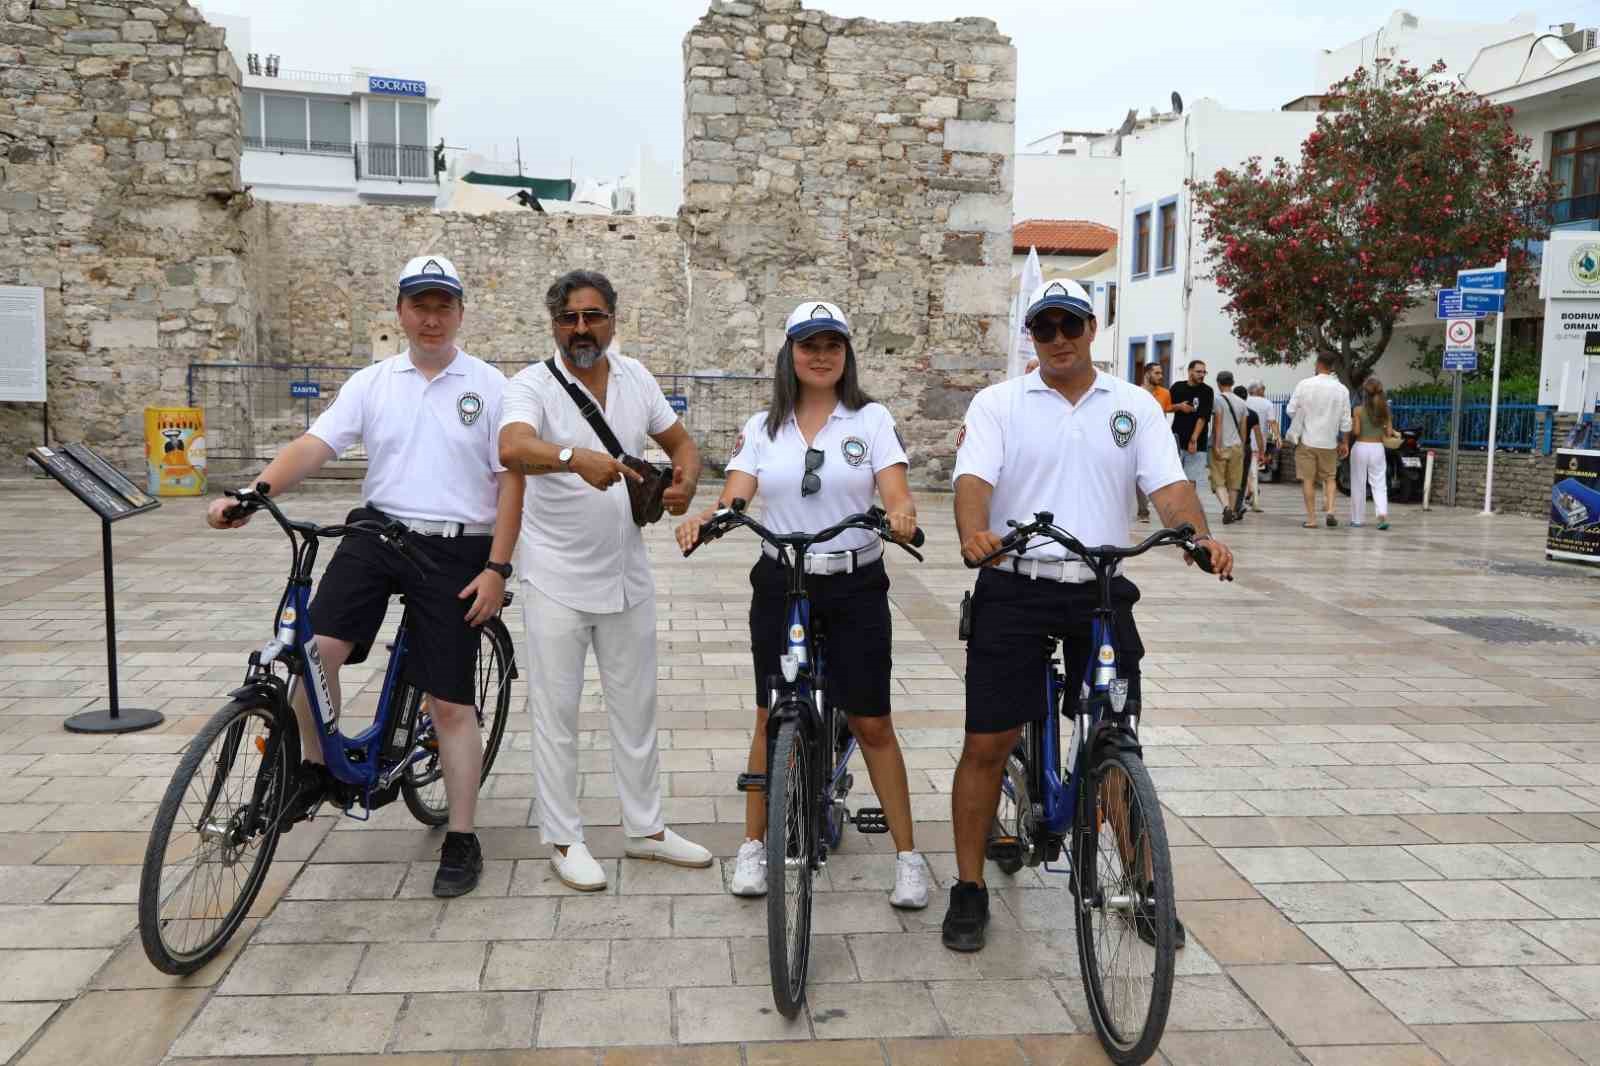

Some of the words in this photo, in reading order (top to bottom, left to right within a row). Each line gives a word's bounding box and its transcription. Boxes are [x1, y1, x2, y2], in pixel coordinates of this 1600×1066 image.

[370, 78, 425, 93] SOCRATES
[1561, 312, 1600, 321] BODRUM
[1563, 323, 1598, 331] ORMAN
